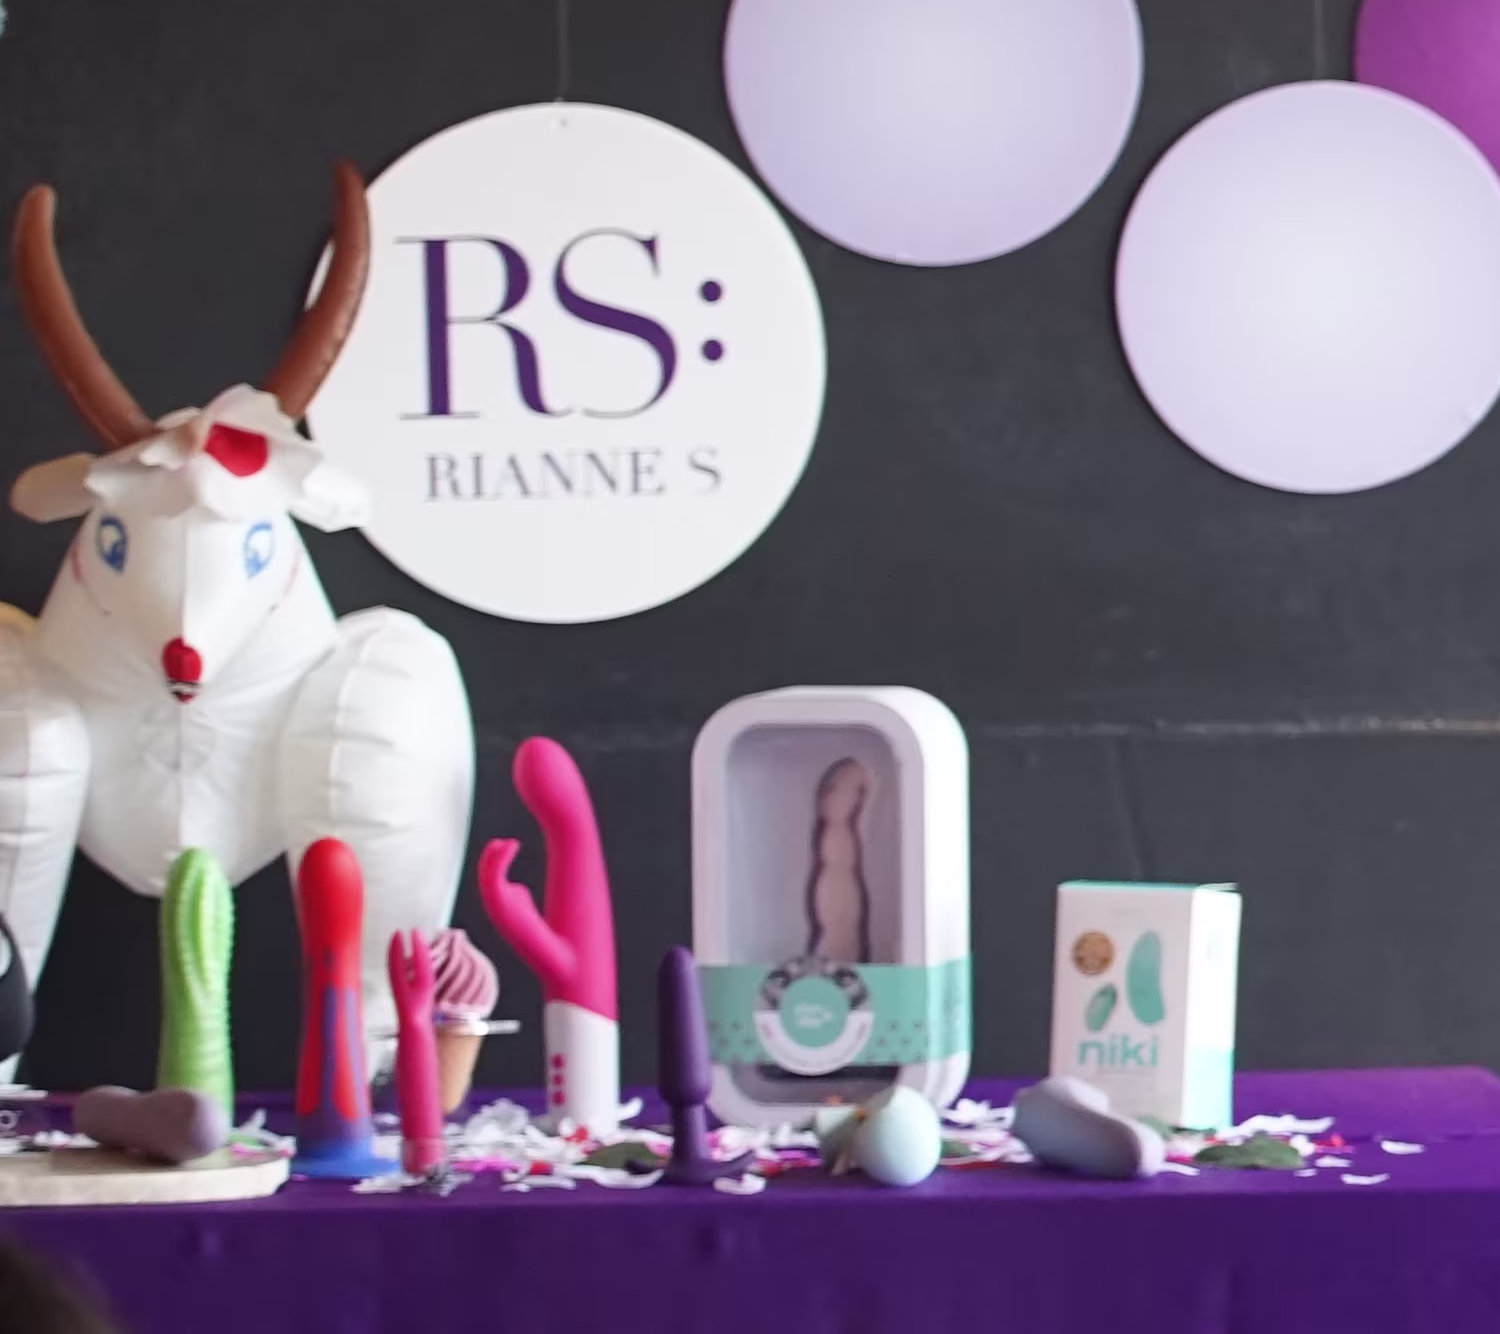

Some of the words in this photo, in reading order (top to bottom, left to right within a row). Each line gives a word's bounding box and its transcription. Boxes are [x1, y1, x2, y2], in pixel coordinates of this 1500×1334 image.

[424, 451, 666, 502] RIANNE
[688, 446, 723, 494] S
[1078, 1035, 1160, 1067] niki
